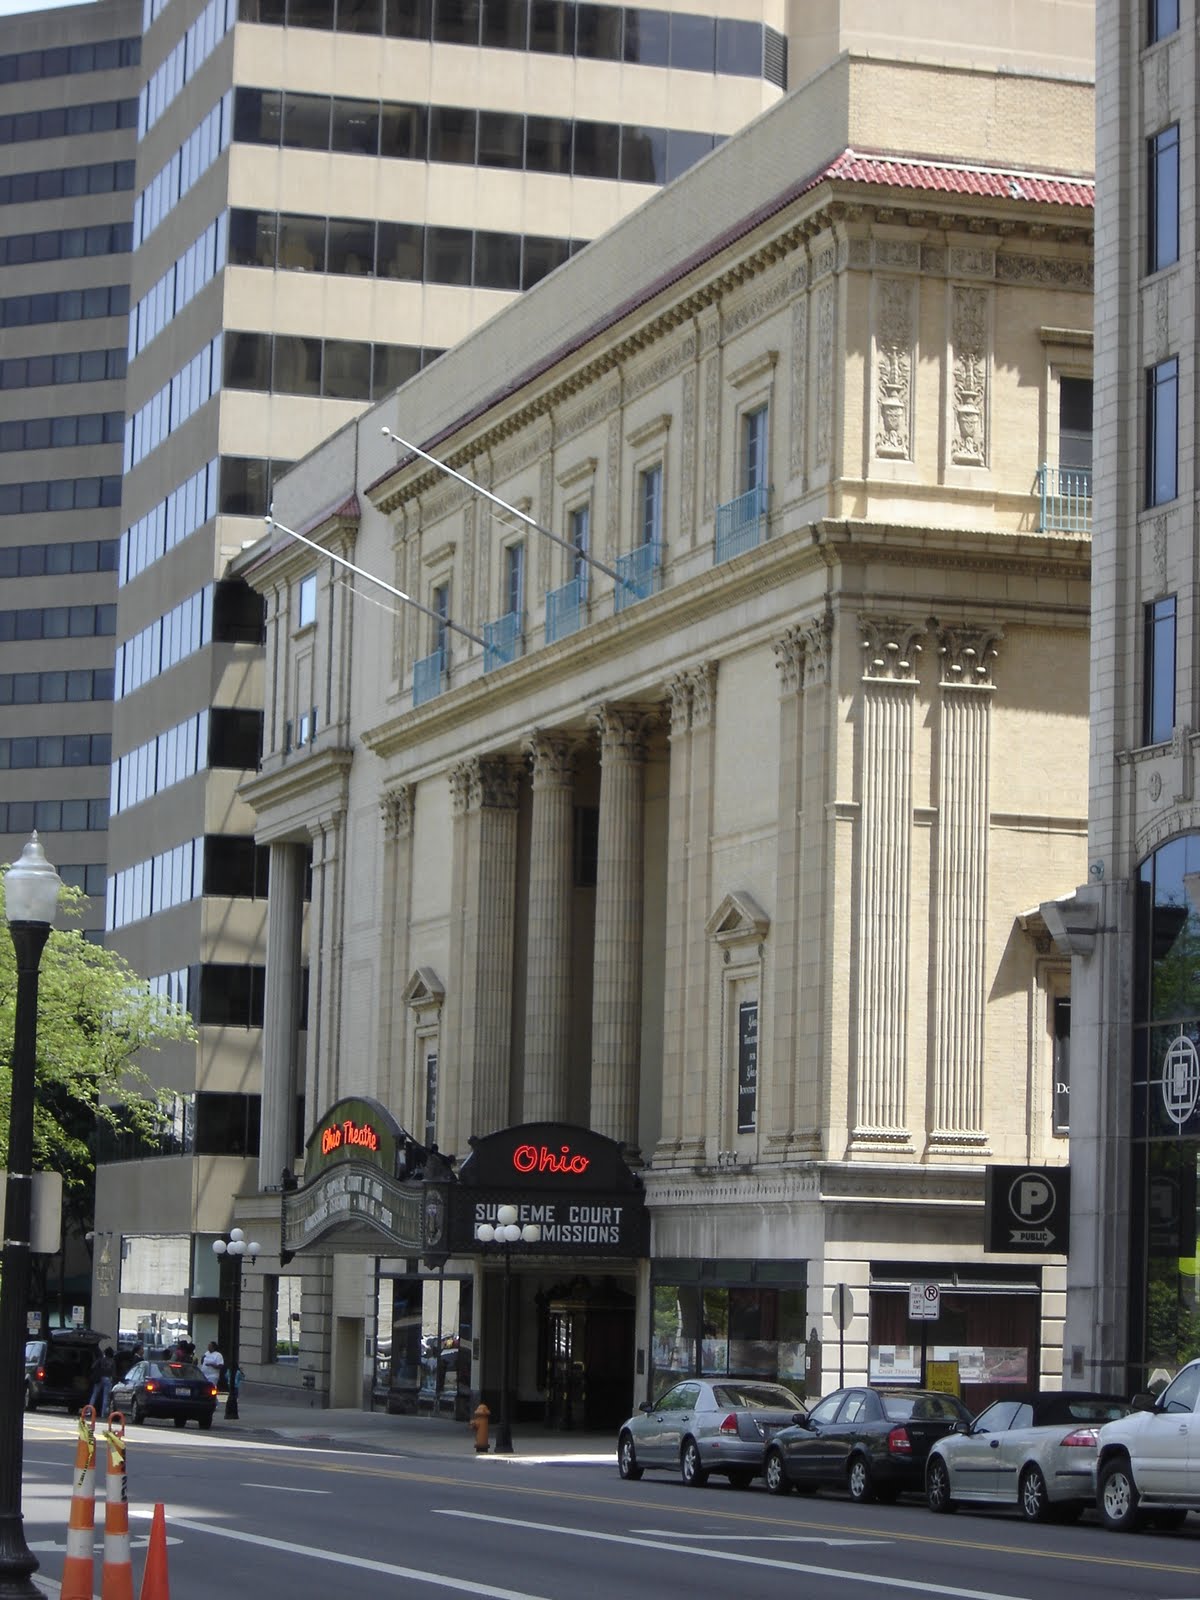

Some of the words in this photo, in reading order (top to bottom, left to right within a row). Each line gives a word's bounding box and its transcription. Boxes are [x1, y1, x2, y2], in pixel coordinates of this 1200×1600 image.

[322, 1123, 341, 1154] Ohio
[343, 1120, 377, 1151] Theatre
[513, 1144, 590, 1174] Ohio
[1020, 1181, 1049, 1215] P
[475, 1203, 555, 1223] SUEME
[569, 1206, 623, 1225] COURT
[520, 1224, 620, 1243] MISSIONS
[1020, 1232, 1048, 1241] PUBLIC
